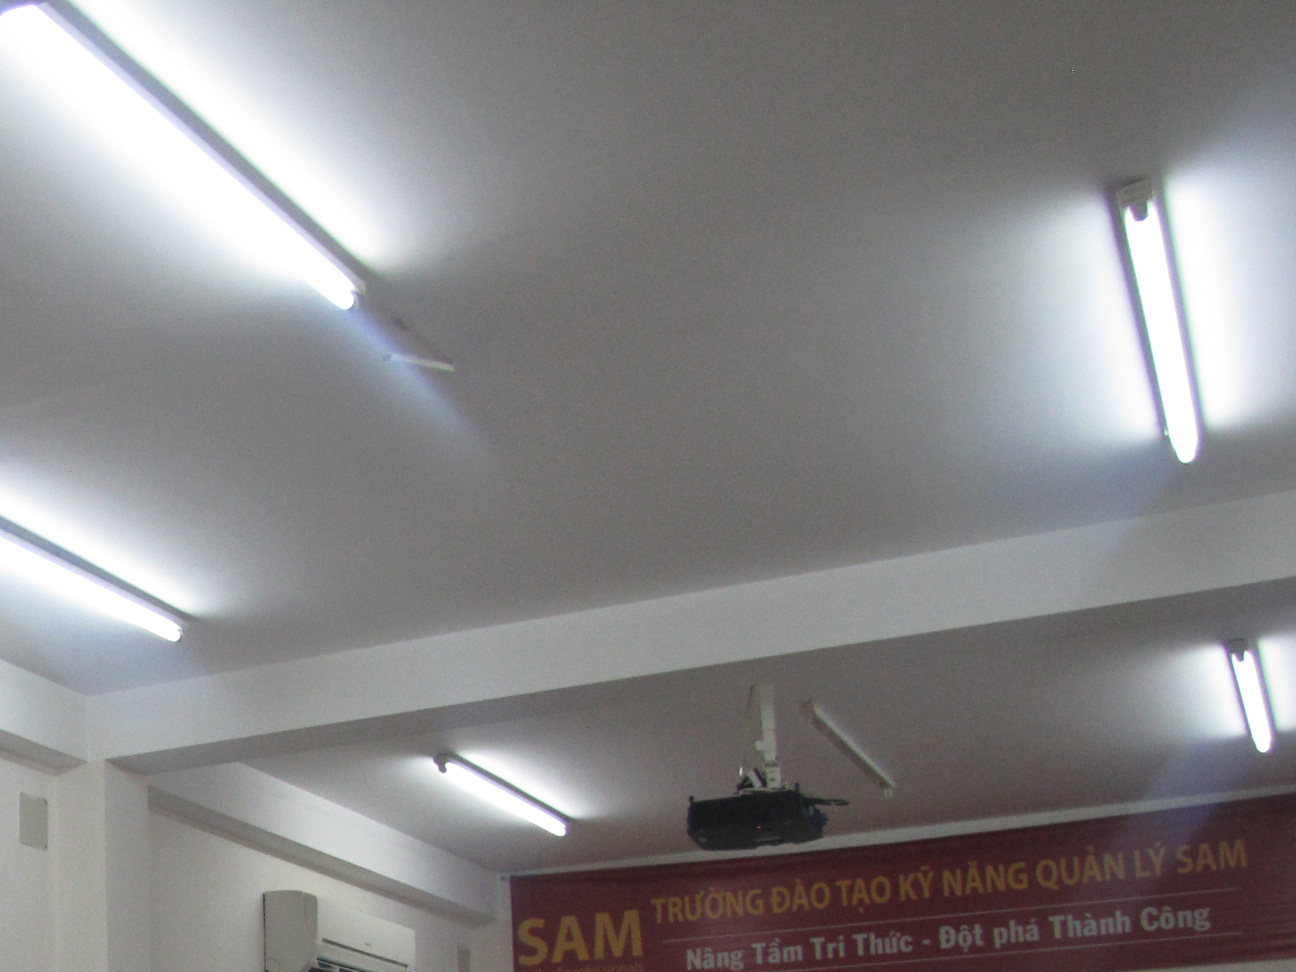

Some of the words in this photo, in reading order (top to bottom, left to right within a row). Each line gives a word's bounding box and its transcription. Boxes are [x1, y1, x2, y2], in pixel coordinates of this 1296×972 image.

[651, 887, 764, 924] TRƯỜNG
[771, 878, 831, 914] ĐÀO
[836, 876, 891, 914] TẠO
[899, 865, 935, 902] KỸ
[942, 861, 1029, 898] NĂNG
[1036, 846, 1126, 891] QUẢN
[1134, 842, 1168, 878] LÝ
[1176, 839, 1248, 875] SAM
[517, 909, 644, 966] SAM
[686, 947, 745, 971] Nâng
[751, 938, 804, 965] Tầm
[809, 935, 846, 962] Tri
[852, 931, 913, 957] Thức
[938, 925, 984, 953] Đột
[993, 918, 1040, 949] phá
[1049, 910, 1132, 940] Thành
[1140, 906, 1212, 932] Công
